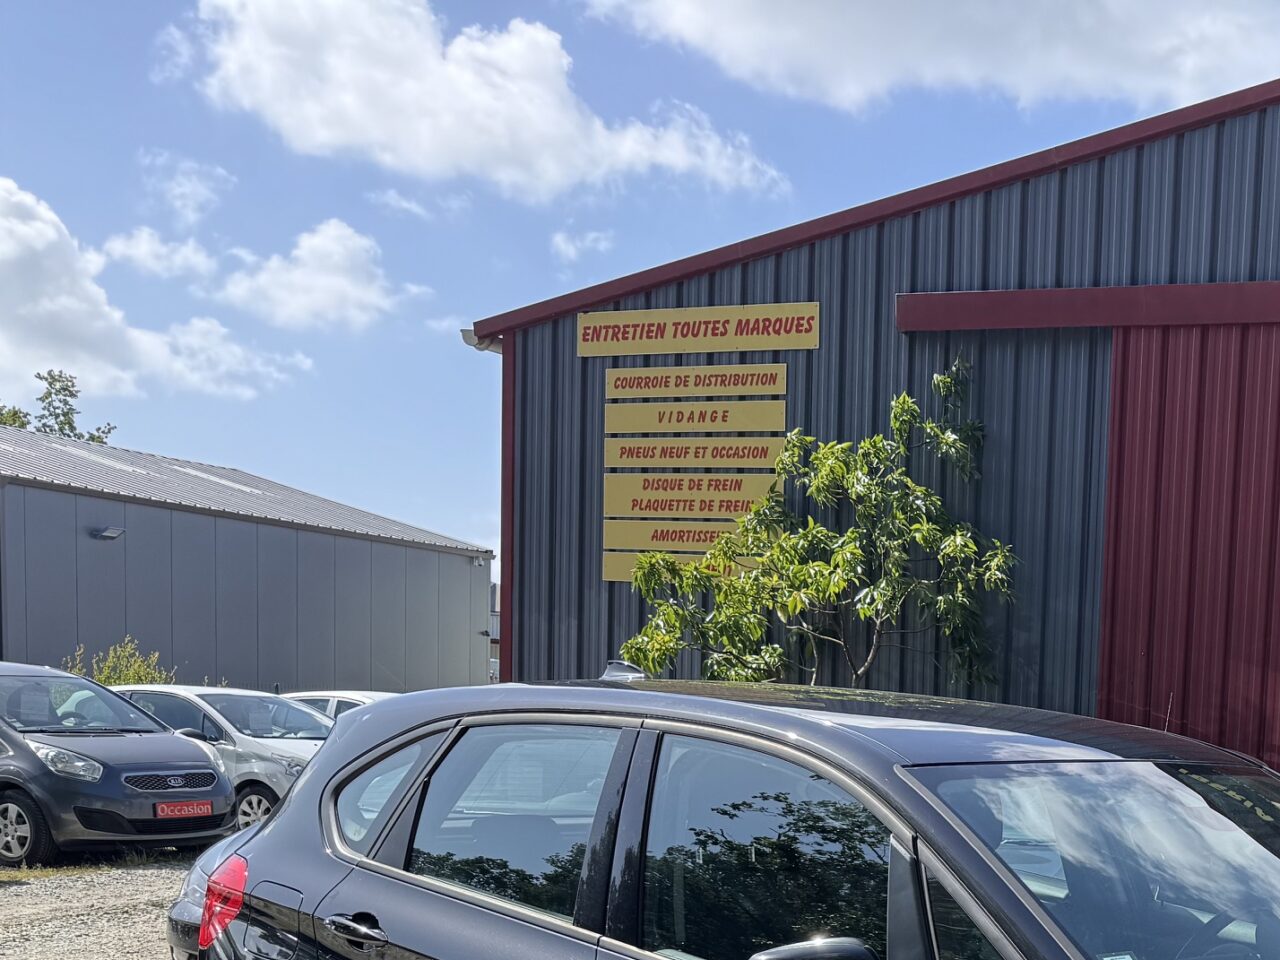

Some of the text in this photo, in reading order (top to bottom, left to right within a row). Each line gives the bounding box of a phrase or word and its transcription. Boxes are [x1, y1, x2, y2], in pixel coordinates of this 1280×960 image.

[582, 316, 815, 343] ENTRETIEN TOUTES MARQUES
[614, 372, 778, 390] COURROIE DE DISTRIBUTION
[657, 410, 729, 424] VIDANGE
[619, 445, 769, 460] PNEUS NEUF ET OCCASION
[642, 478, 743, 492] DISQUE DE FREIN
[631, 498, 695, 512] PLAQUETTE
[699, 499, 715, 512] DE
[651, 529, 732, 543] AMORTISSE
[158, 803, 212, 816] Occasion
